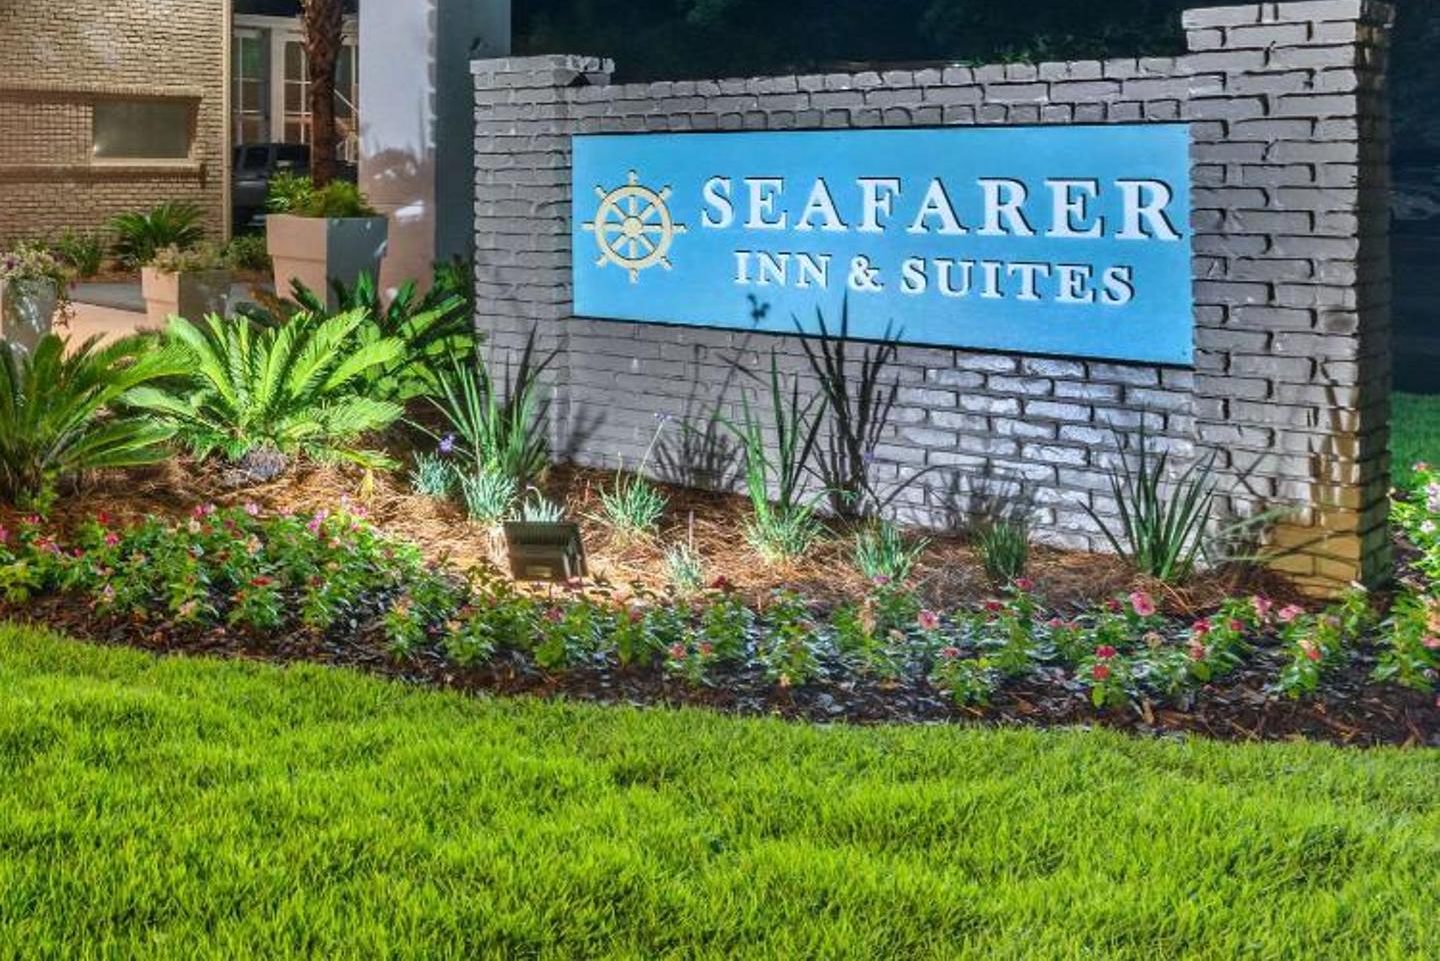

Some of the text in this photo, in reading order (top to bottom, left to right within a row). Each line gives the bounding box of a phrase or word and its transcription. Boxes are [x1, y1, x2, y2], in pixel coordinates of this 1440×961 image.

[700, 176, 1183, 240] SEAFARER
[733, 250, 1135, 305] INN & SUITES
